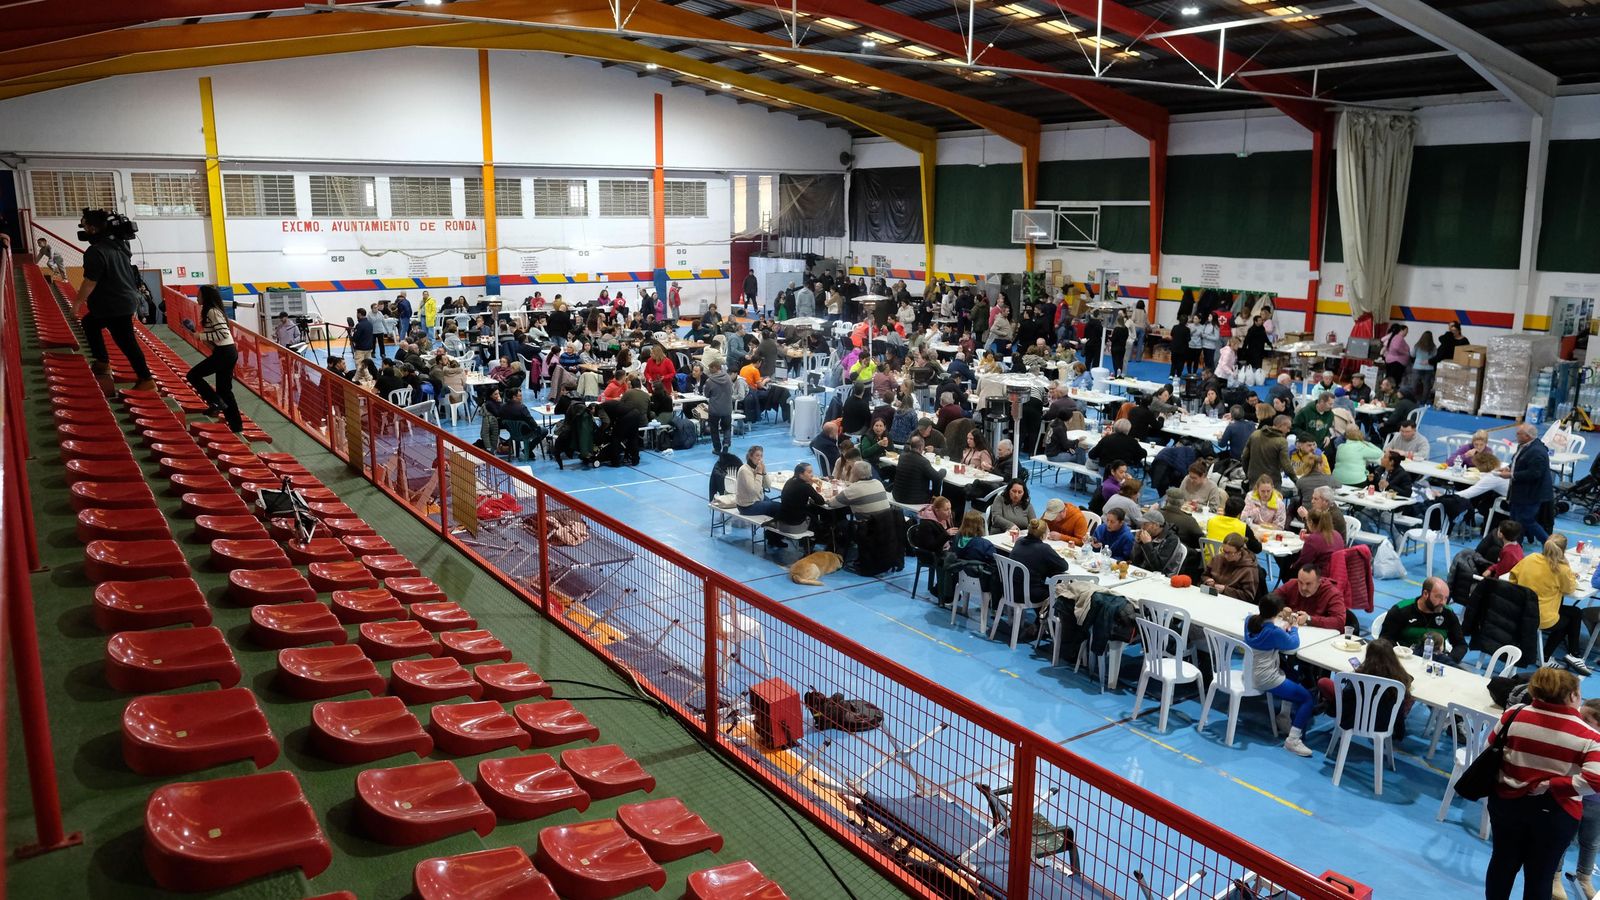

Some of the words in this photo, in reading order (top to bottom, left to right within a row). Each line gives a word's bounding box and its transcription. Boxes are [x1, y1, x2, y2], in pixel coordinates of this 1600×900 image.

[282, 221, 324, 232] EXCMO.
[332, 220, 410, 232] AYUNTAMIENTO
[420, 222, 436, 231] DE
[445, 220, 477, 231] RONDA
